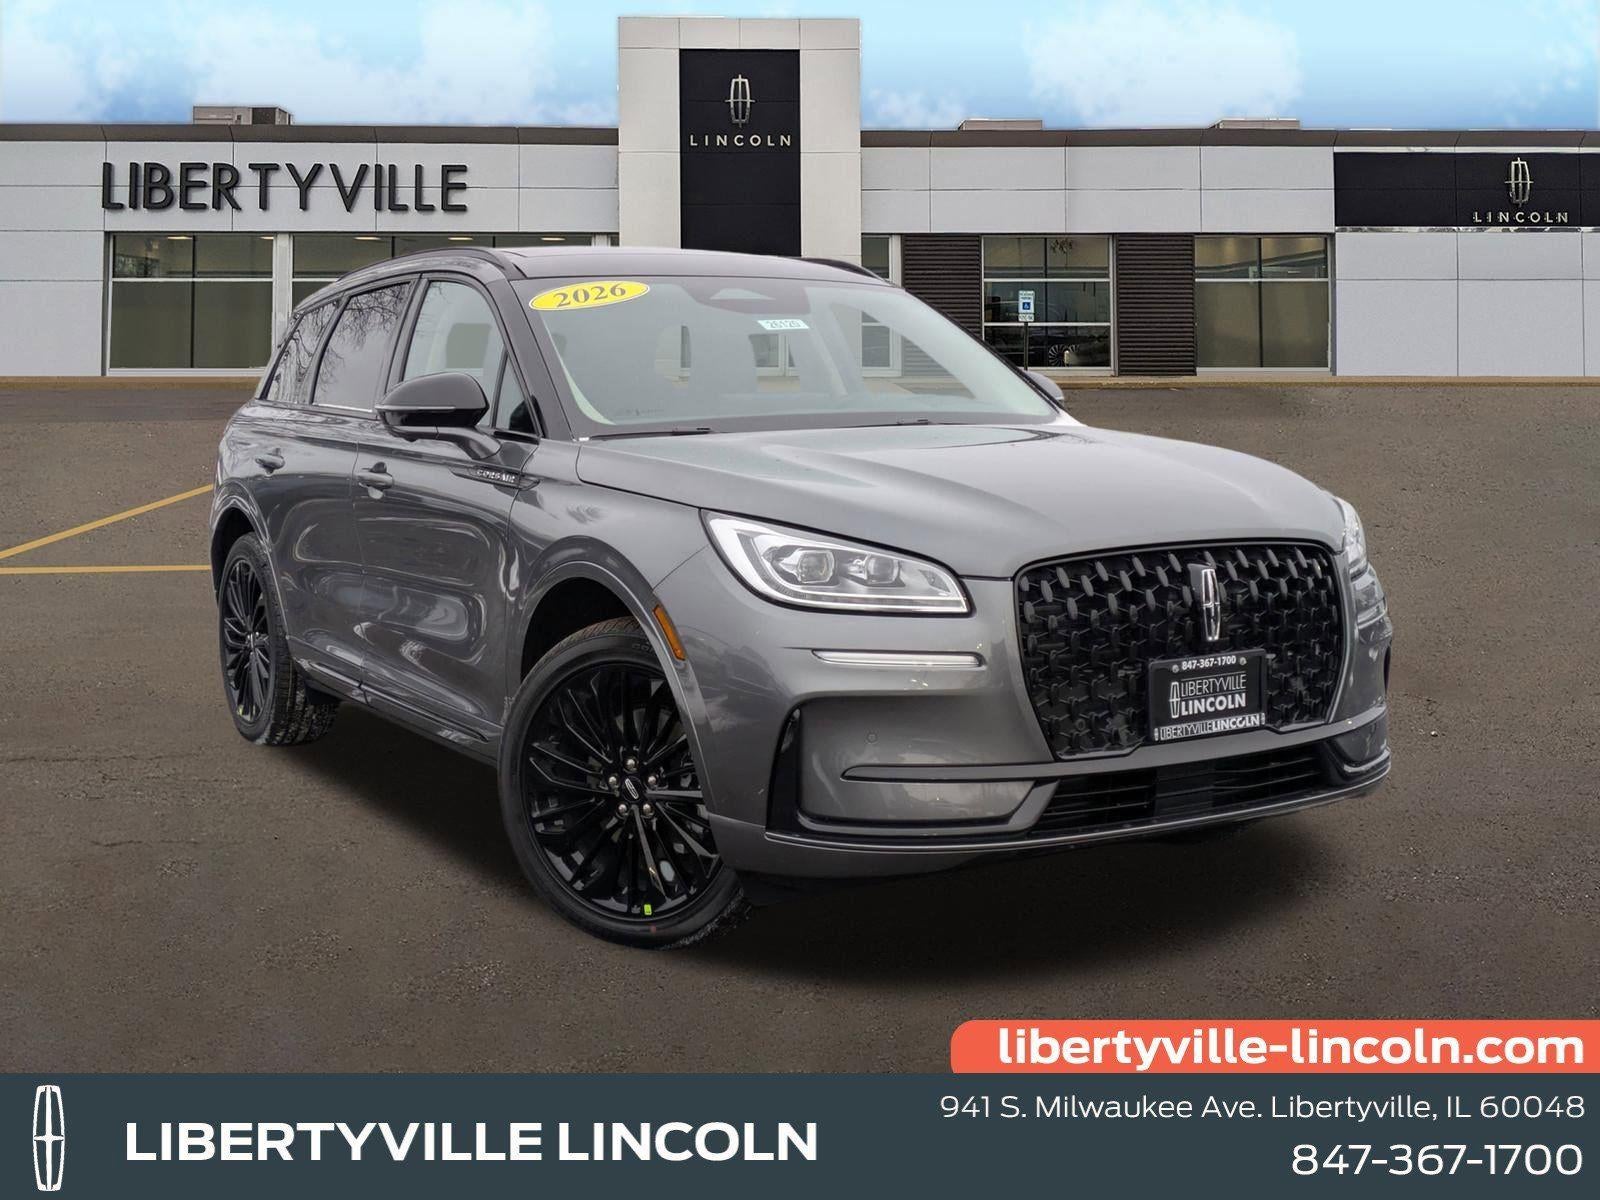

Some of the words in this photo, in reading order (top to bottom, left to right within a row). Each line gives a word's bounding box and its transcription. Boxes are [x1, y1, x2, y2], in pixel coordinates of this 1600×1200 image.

[690, 134, 791, 147] LINCOLN
[101, 162, 468, 213] LIBERTYVILLE
[1473, 211, 1568, 223] LINCOLN
[553, 282, 626, 308] 2026
[1181, 655, 1237, 670] 847-367-1700
[1181, 674, 1247, 697] LIBERTYVILLE
[1181, 693, 1246, 716] LINCOLN
